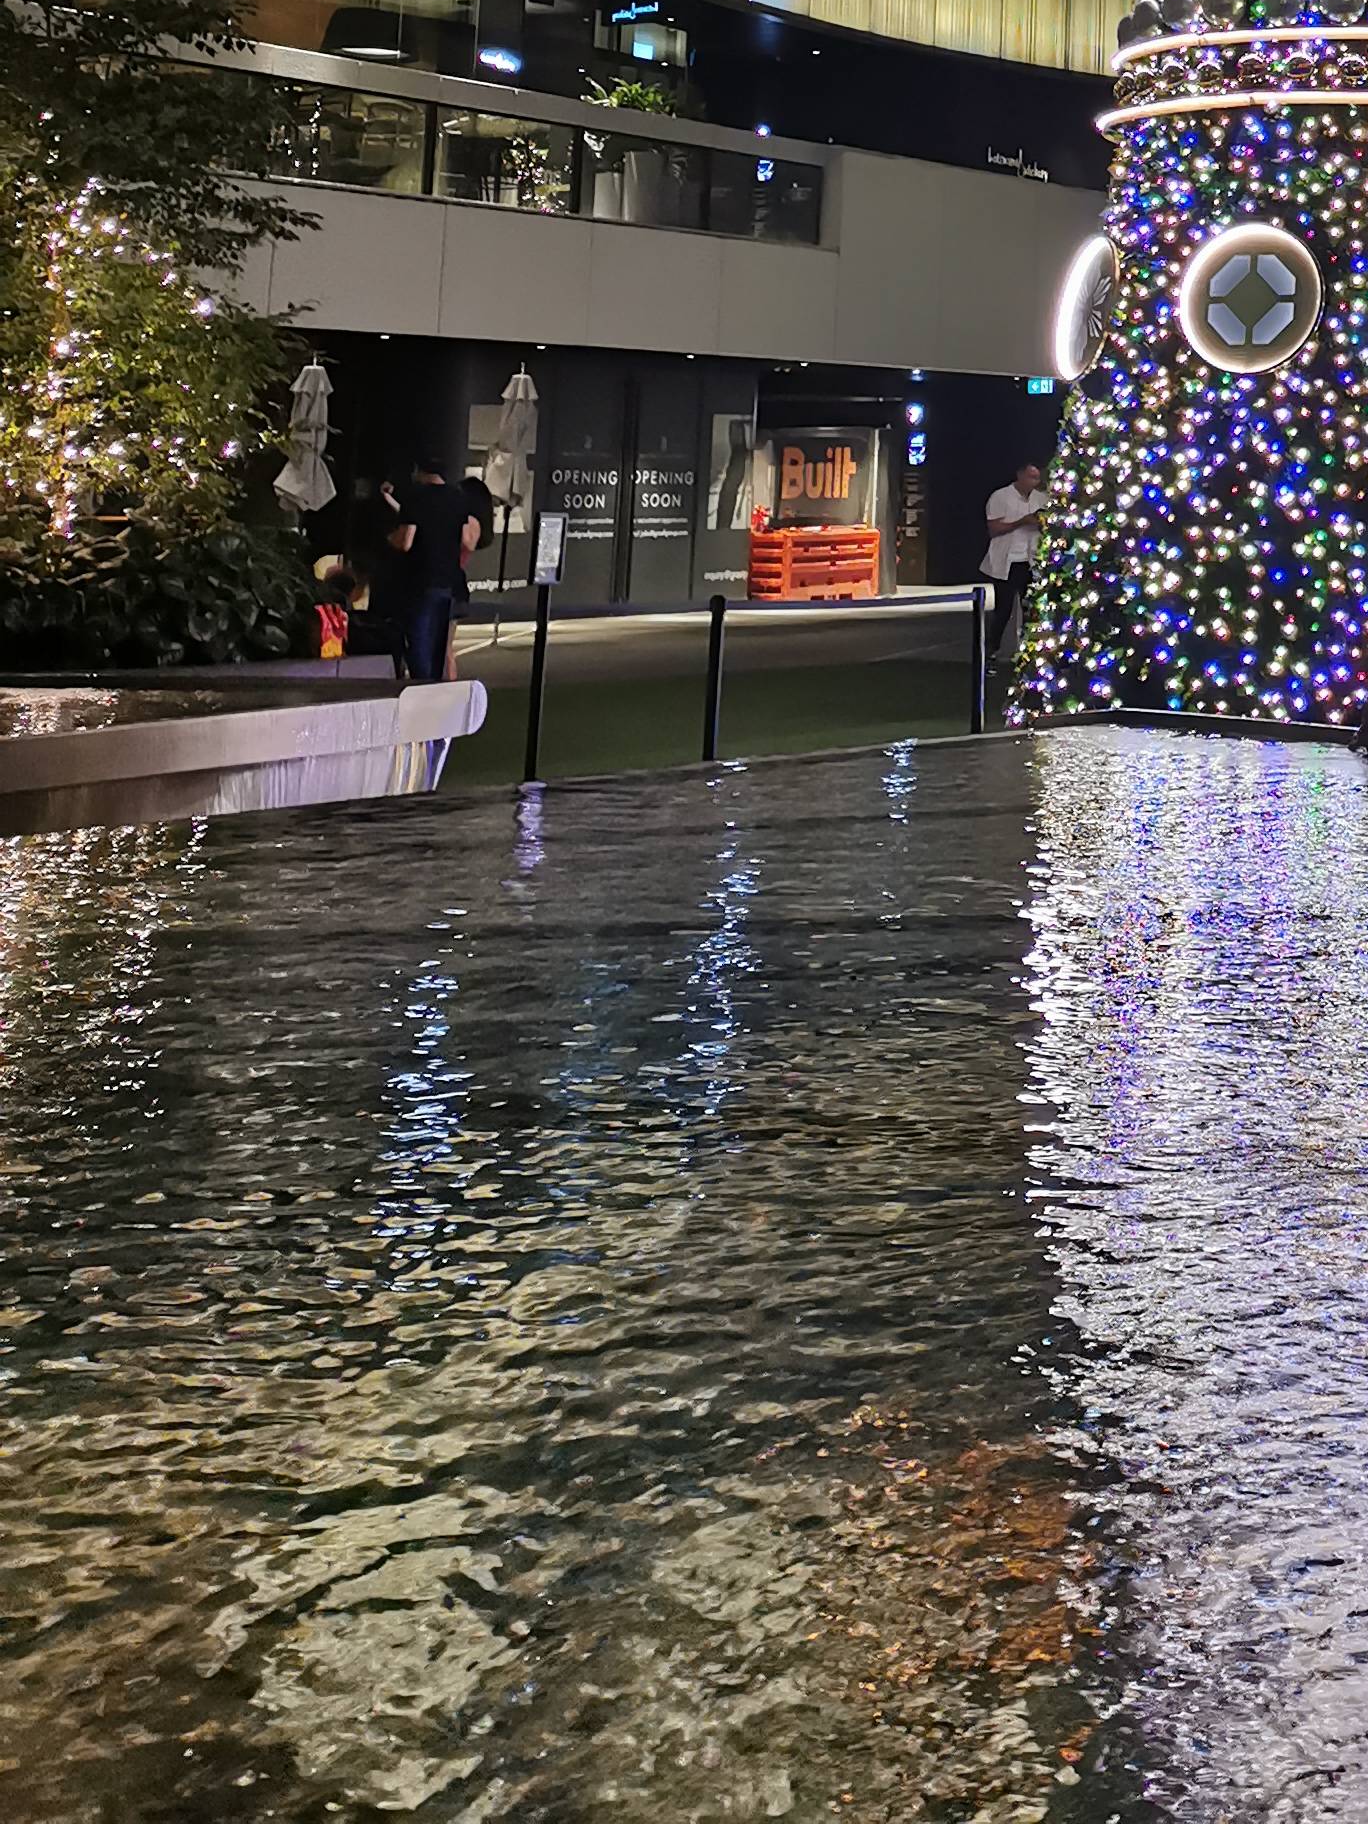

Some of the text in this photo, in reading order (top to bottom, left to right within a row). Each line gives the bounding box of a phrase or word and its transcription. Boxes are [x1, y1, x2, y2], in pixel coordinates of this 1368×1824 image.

[552, 470, 618, 485] OPENING
[781, 446, 857, 500] Built
[563, 494, 606, 508] SOON
[641, 493, 682, 508] SOON
